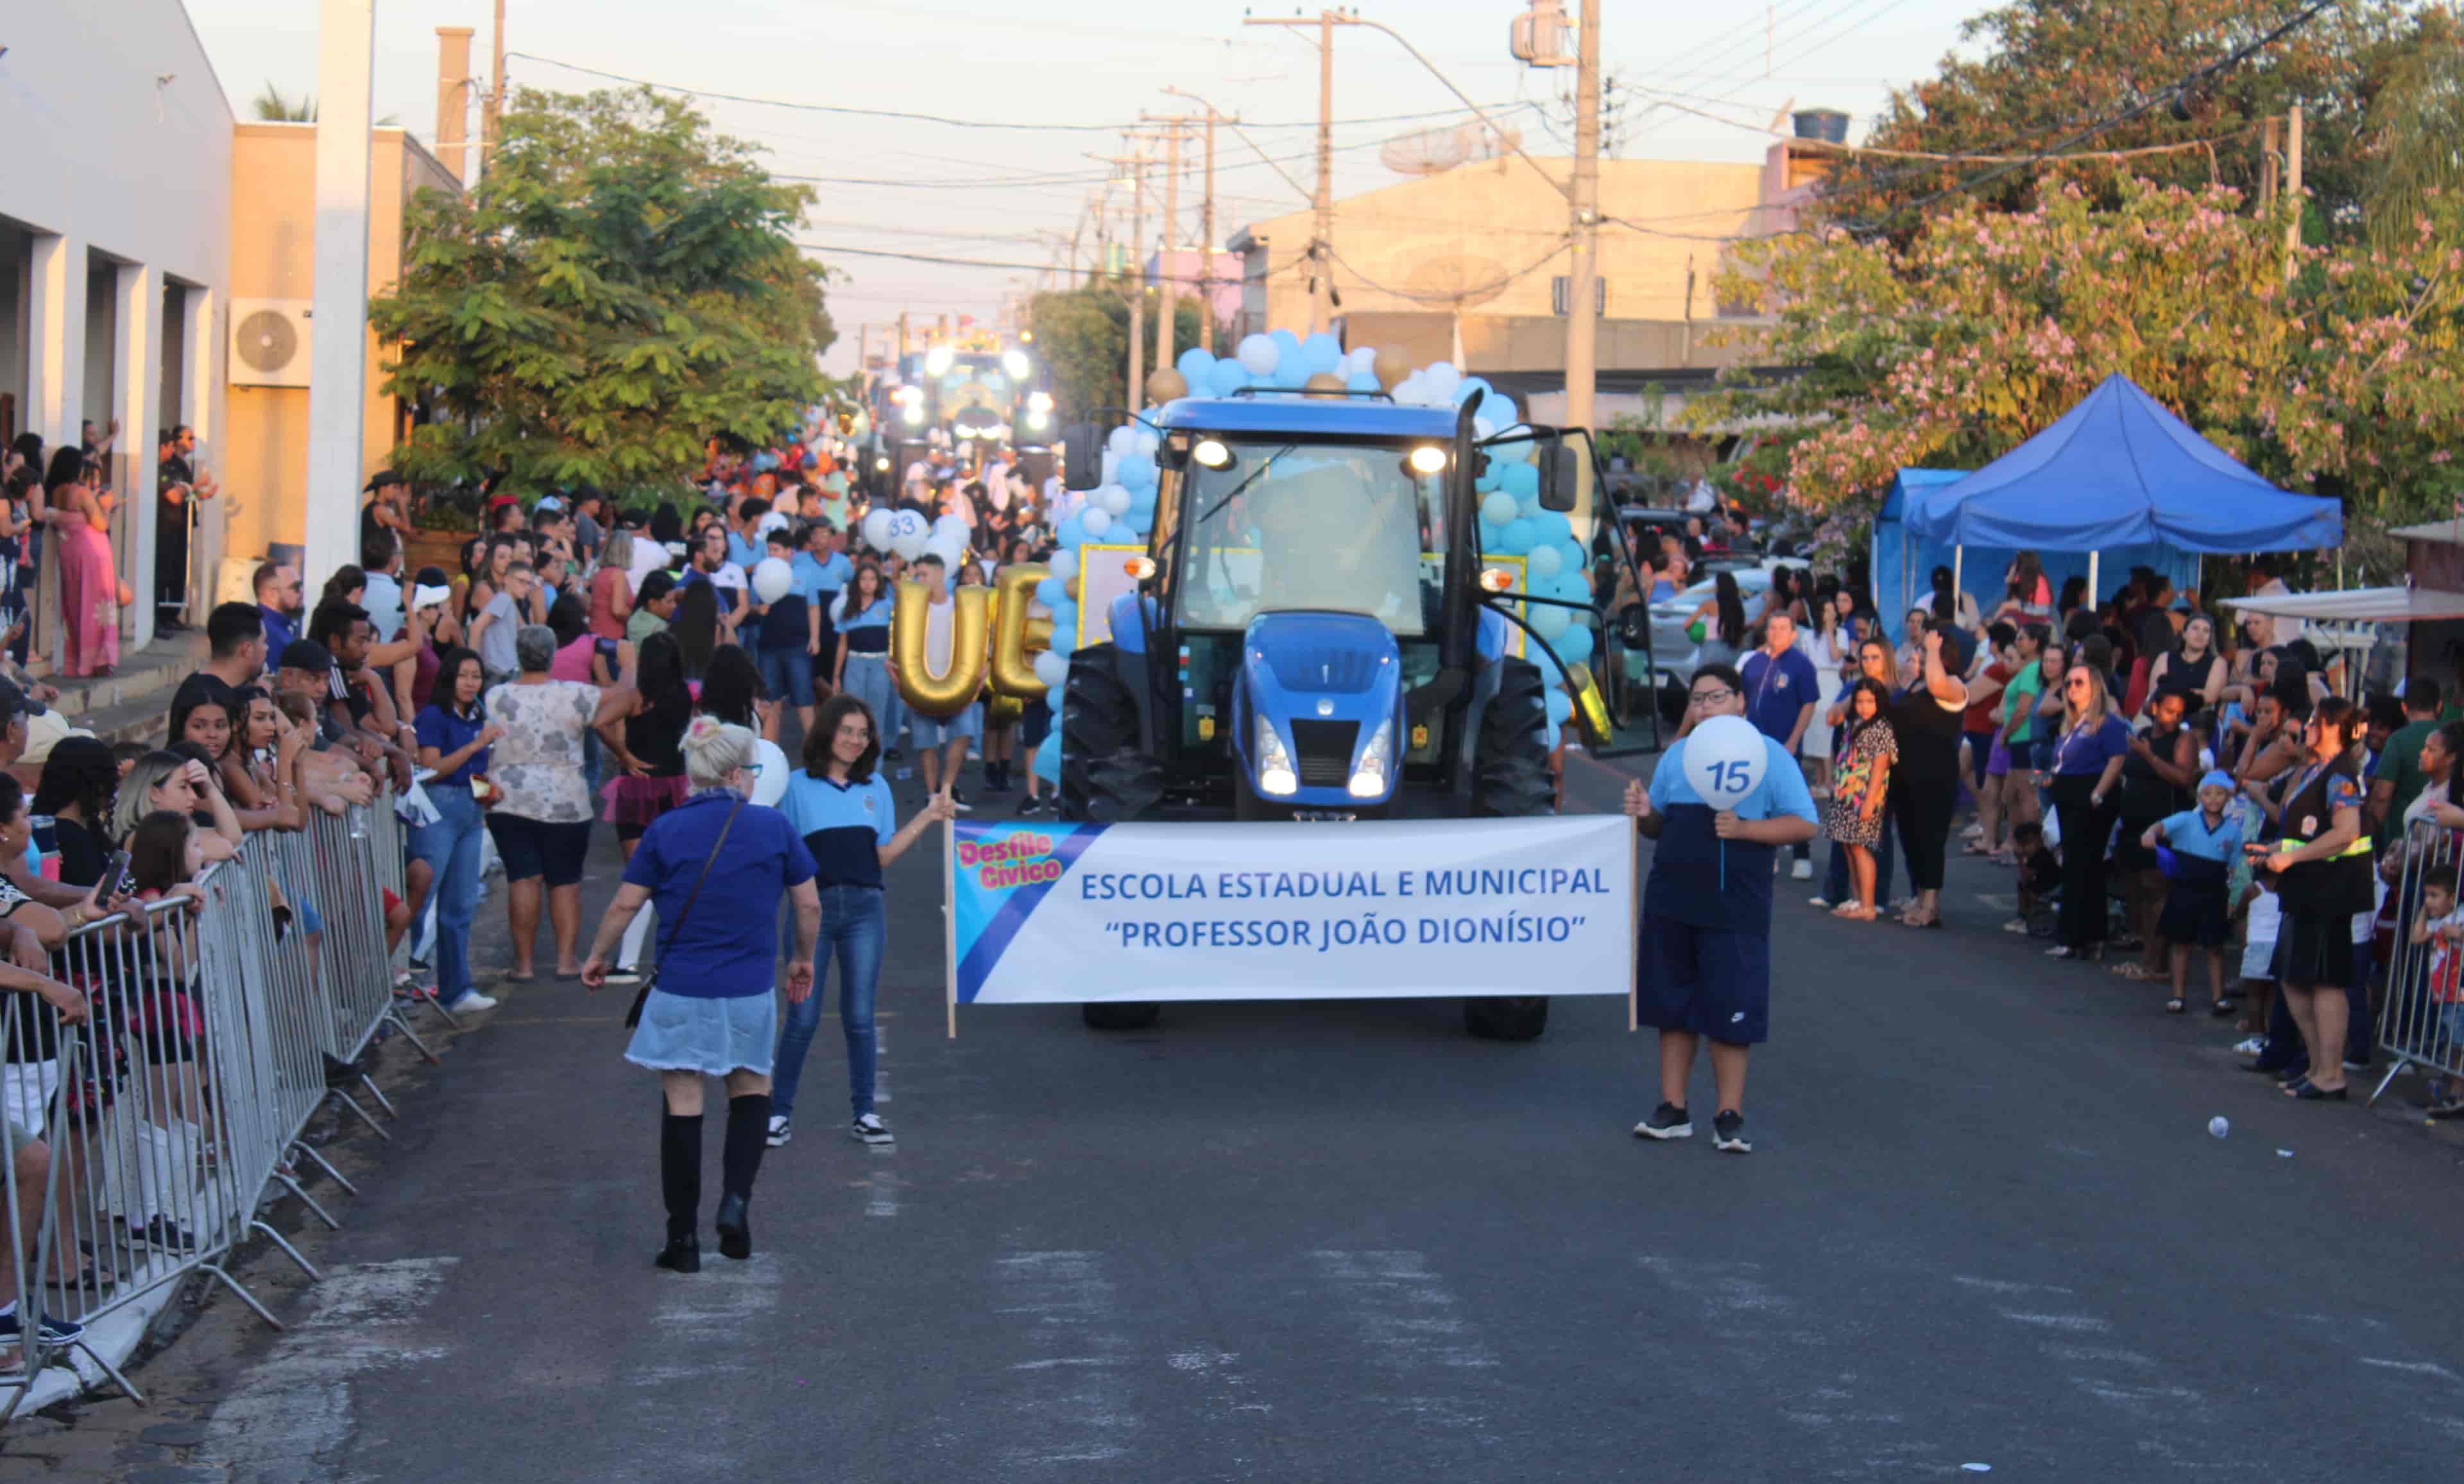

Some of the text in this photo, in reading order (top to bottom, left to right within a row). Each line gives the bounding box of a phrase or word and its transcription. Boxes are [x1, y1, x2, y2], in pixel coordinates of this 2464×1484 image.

[1706, 760, 1750, 793] 15
[958, 831, 1052, 866] Desfile
[1082, 868, 1610, 899] ESCOLA ESTADUAL E MUNICIPAL
[1105, 909, 1586, 952] “PROFESSOR JOÃO DIONÍSIO”
